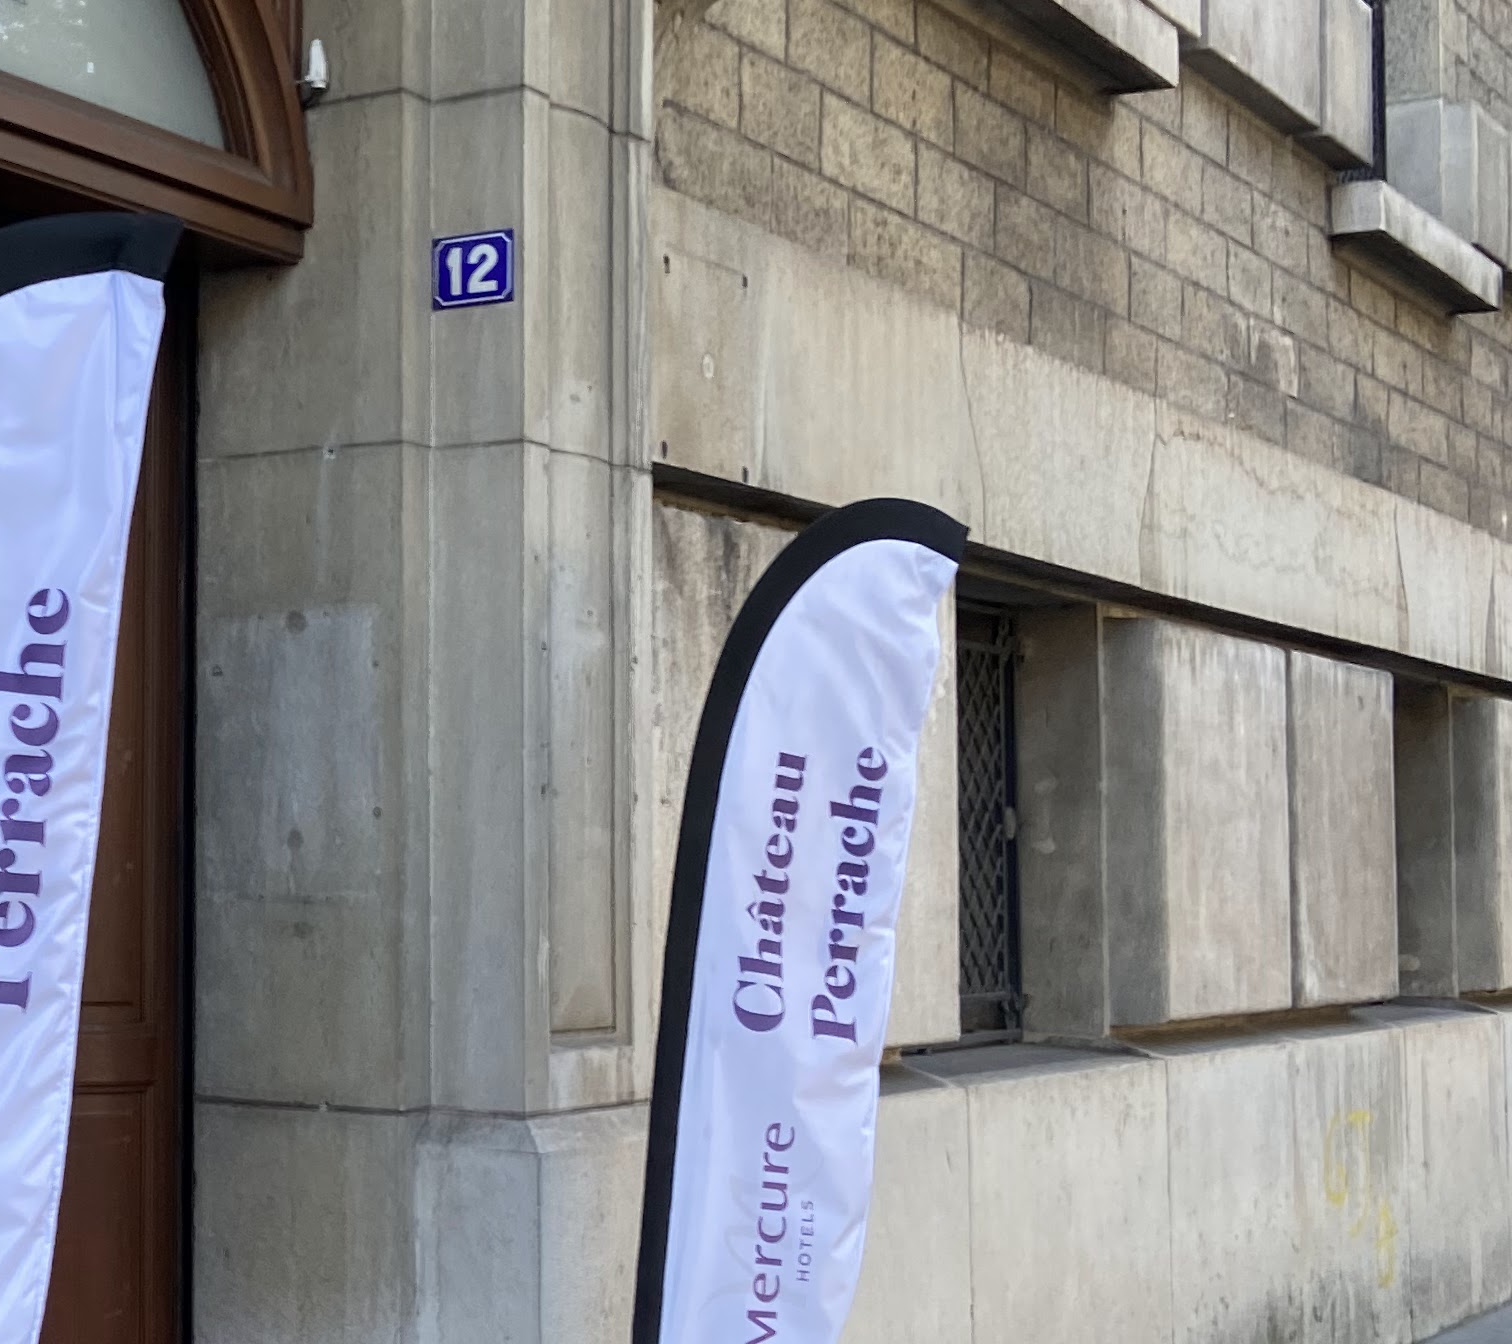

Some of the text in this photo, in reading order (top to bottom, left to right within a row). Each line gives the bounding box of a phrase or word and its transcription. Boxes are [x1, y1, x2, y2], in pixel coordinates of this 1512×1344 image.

[446, 243, 498, 296] 12
[733, 751, 807, 1032] Château
[811, 746, 888, 1047] Perrache
[796, 1200, 815, 1282] HOTELS
